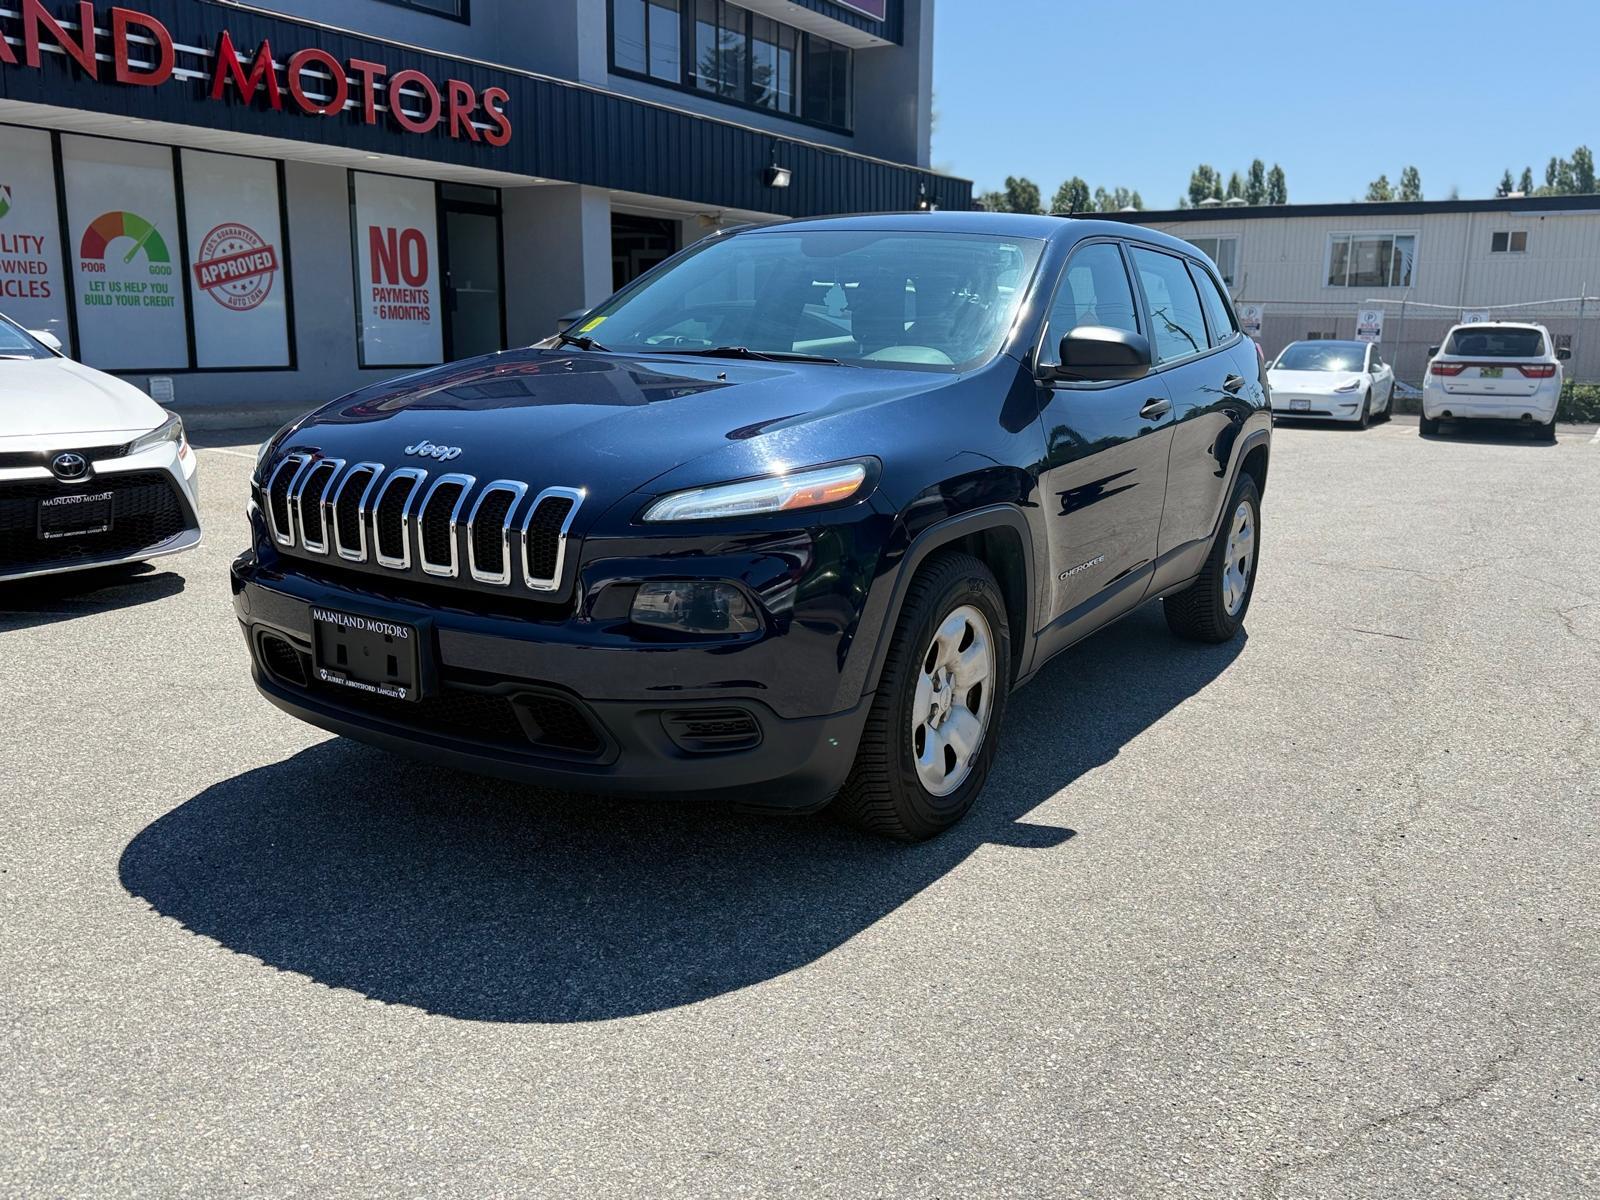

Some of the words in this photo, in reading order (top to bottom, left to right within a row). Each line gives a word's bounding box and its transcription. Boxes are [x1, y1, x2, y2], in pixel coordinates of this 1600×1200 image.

[211, 29, 512, 147] MOTORS
[369, 226, 428, 287] NO
[0, 260, 48, 275] WNED
[81, 262, 106, 272] POOR
[149, 265, 172, 275] GOOD
[201, 251, 273, 284] APPROVED
[89, 281, 105, 291] LET
[109, 282, 122, 292] US
[124, 282, 147, 293] HELP
[150, 283, 168, 293] YOU
[84, 294, 112, 305] BUILD
[115, 295, 141, 306] YOUR
[143, 296, 175, 307] CREDIT
[228, 296, 247, 306] AUTO
[372, 287, 429, 304] PAYMENTS
[380, 305, 387, 320] 6
[388, 305, 430, 320] MONTHS
[404, 439, 462, 462] Jeep
[42, 497, 82, 506] MAINLAND
[313, 609, 365, 629] MAINLAND
[367, 621, 409, 639] MOTORS
[327, 675, 345, 685] SURREY
[345, 678, 376, 692] ABBOTSFORD
[377, 687, 399, 698] LANGLEY
